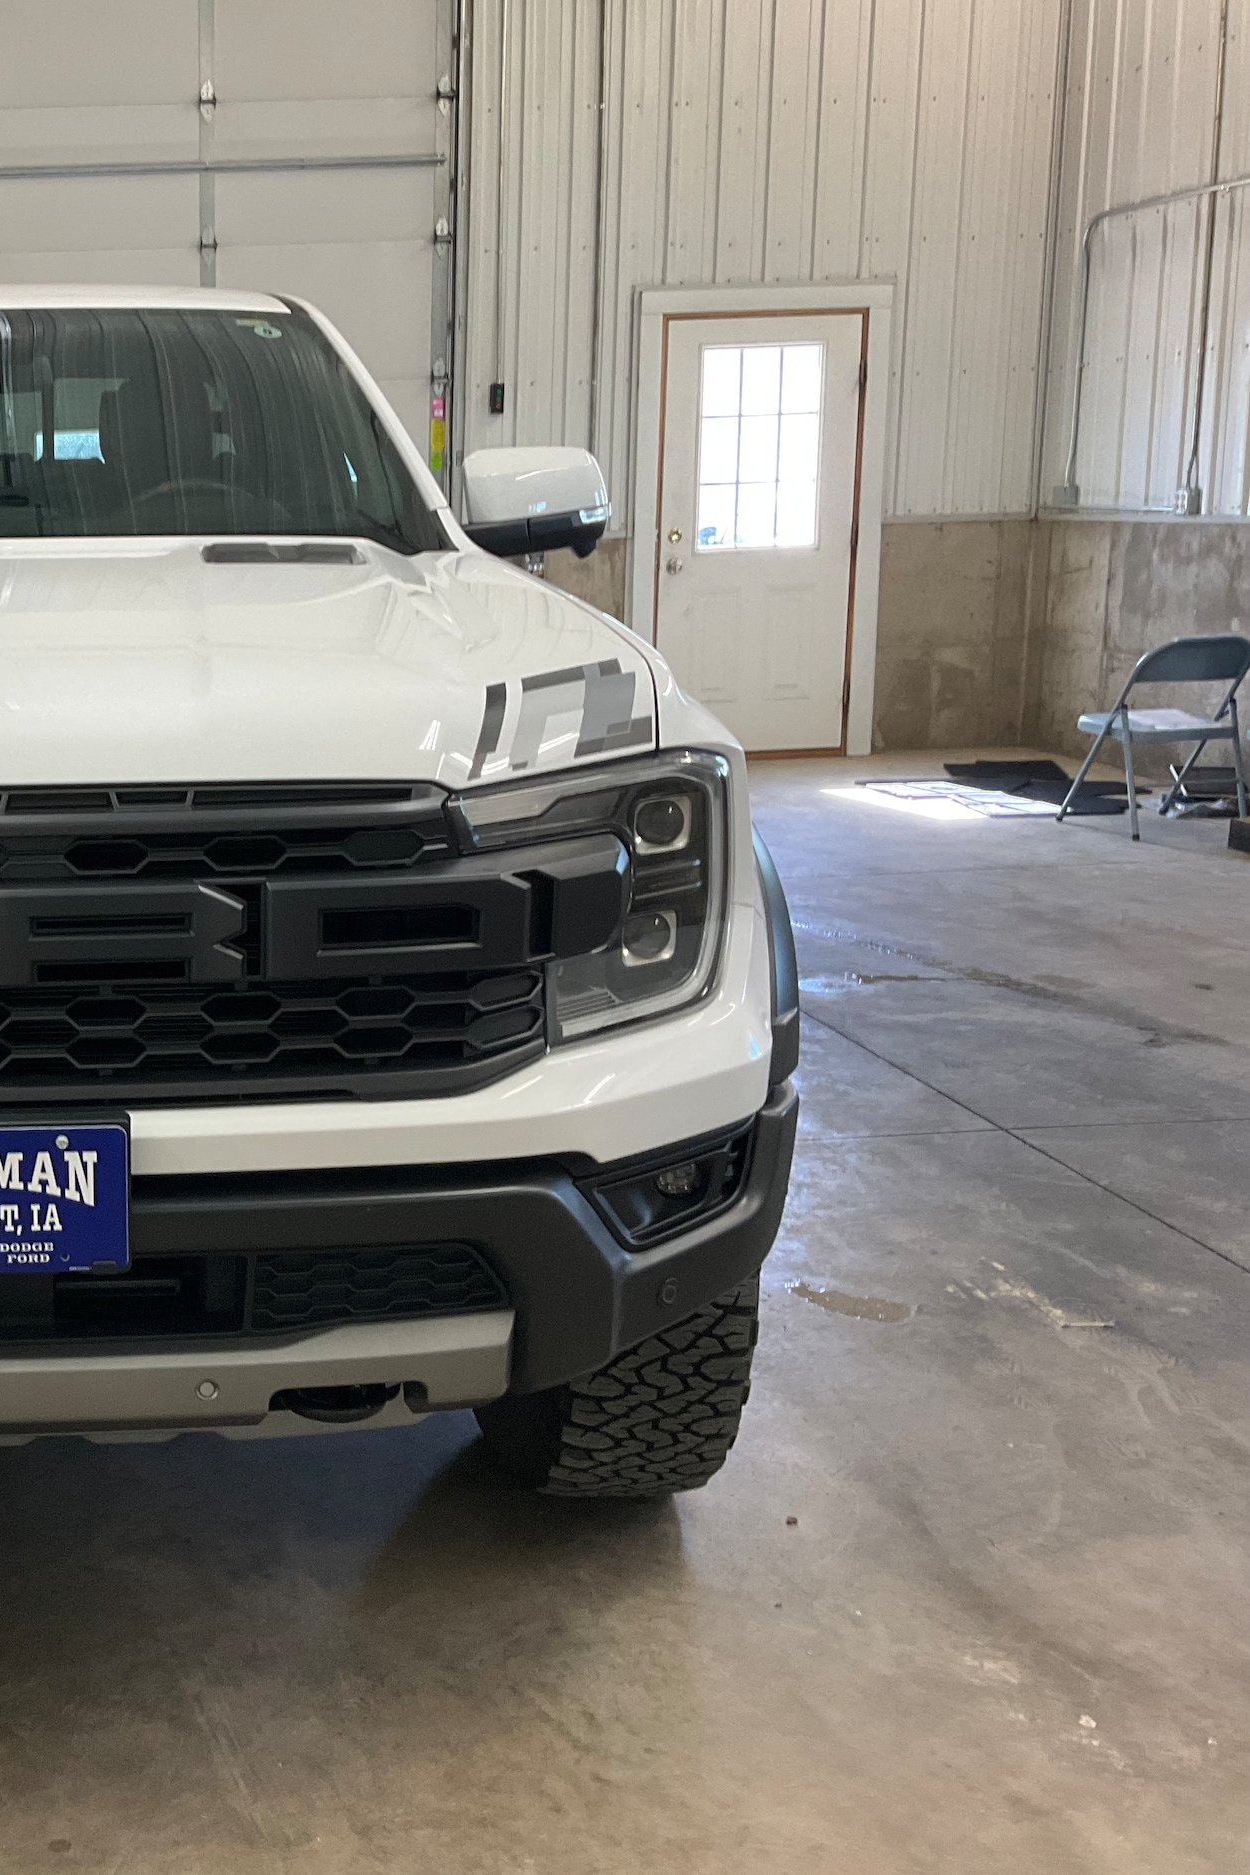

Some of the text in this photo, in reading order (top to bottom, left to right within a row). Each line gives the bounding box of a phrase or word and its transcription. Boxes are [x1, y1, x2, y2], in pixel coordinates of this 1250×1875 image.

[31, 1203, 62, 1231] IA
[0, 1242, 54, 1252] DODGE
[6, 1253, 50, 1264] FORD
